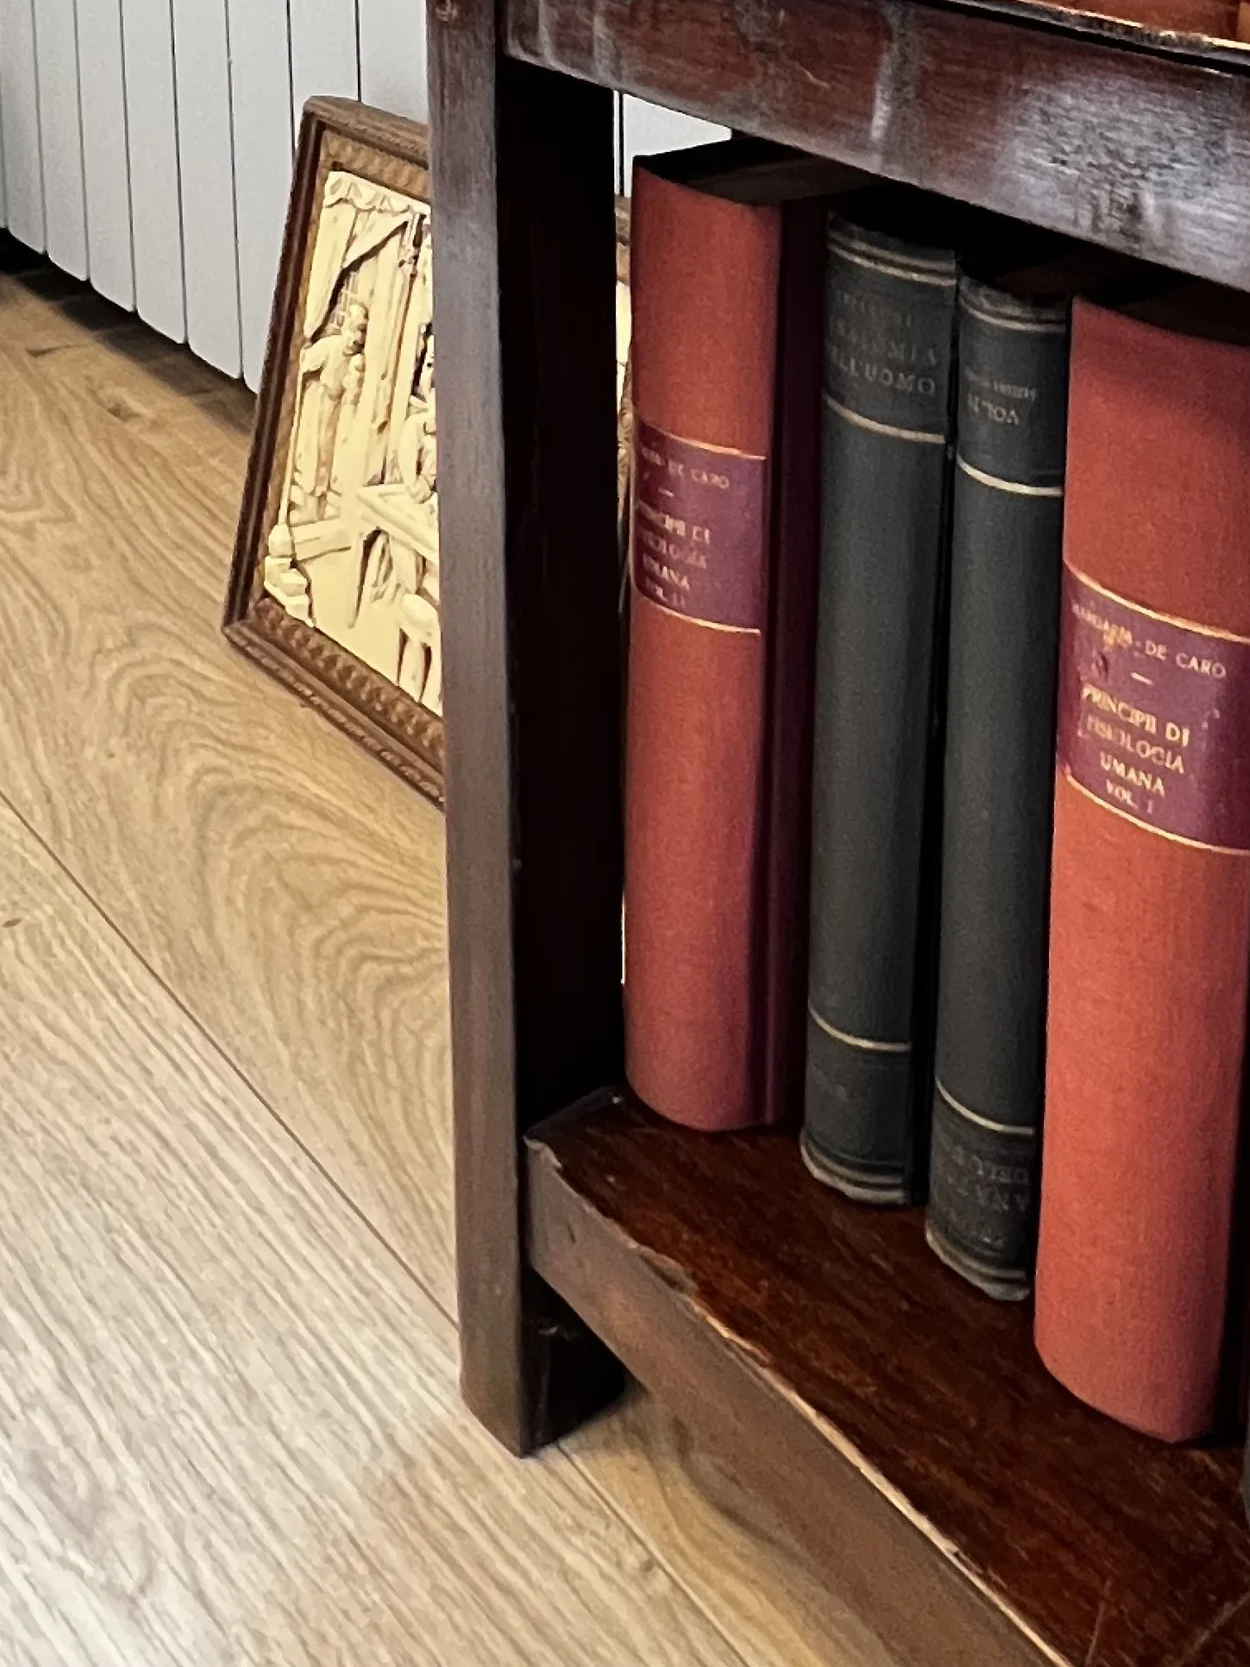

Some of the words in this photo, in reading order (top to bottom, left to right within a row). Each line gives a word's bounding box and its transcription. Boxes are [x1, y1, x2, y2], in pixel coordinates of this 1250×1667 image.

[1145, 639, 1168, 660] DE
[1176, 652, 1227, 679] CARO
[1086, 714, 1184, 774] FISIOLOGIA
[1165, 721, 1190, 747] DI
[1100, 751, 1165, 798] UMANA
